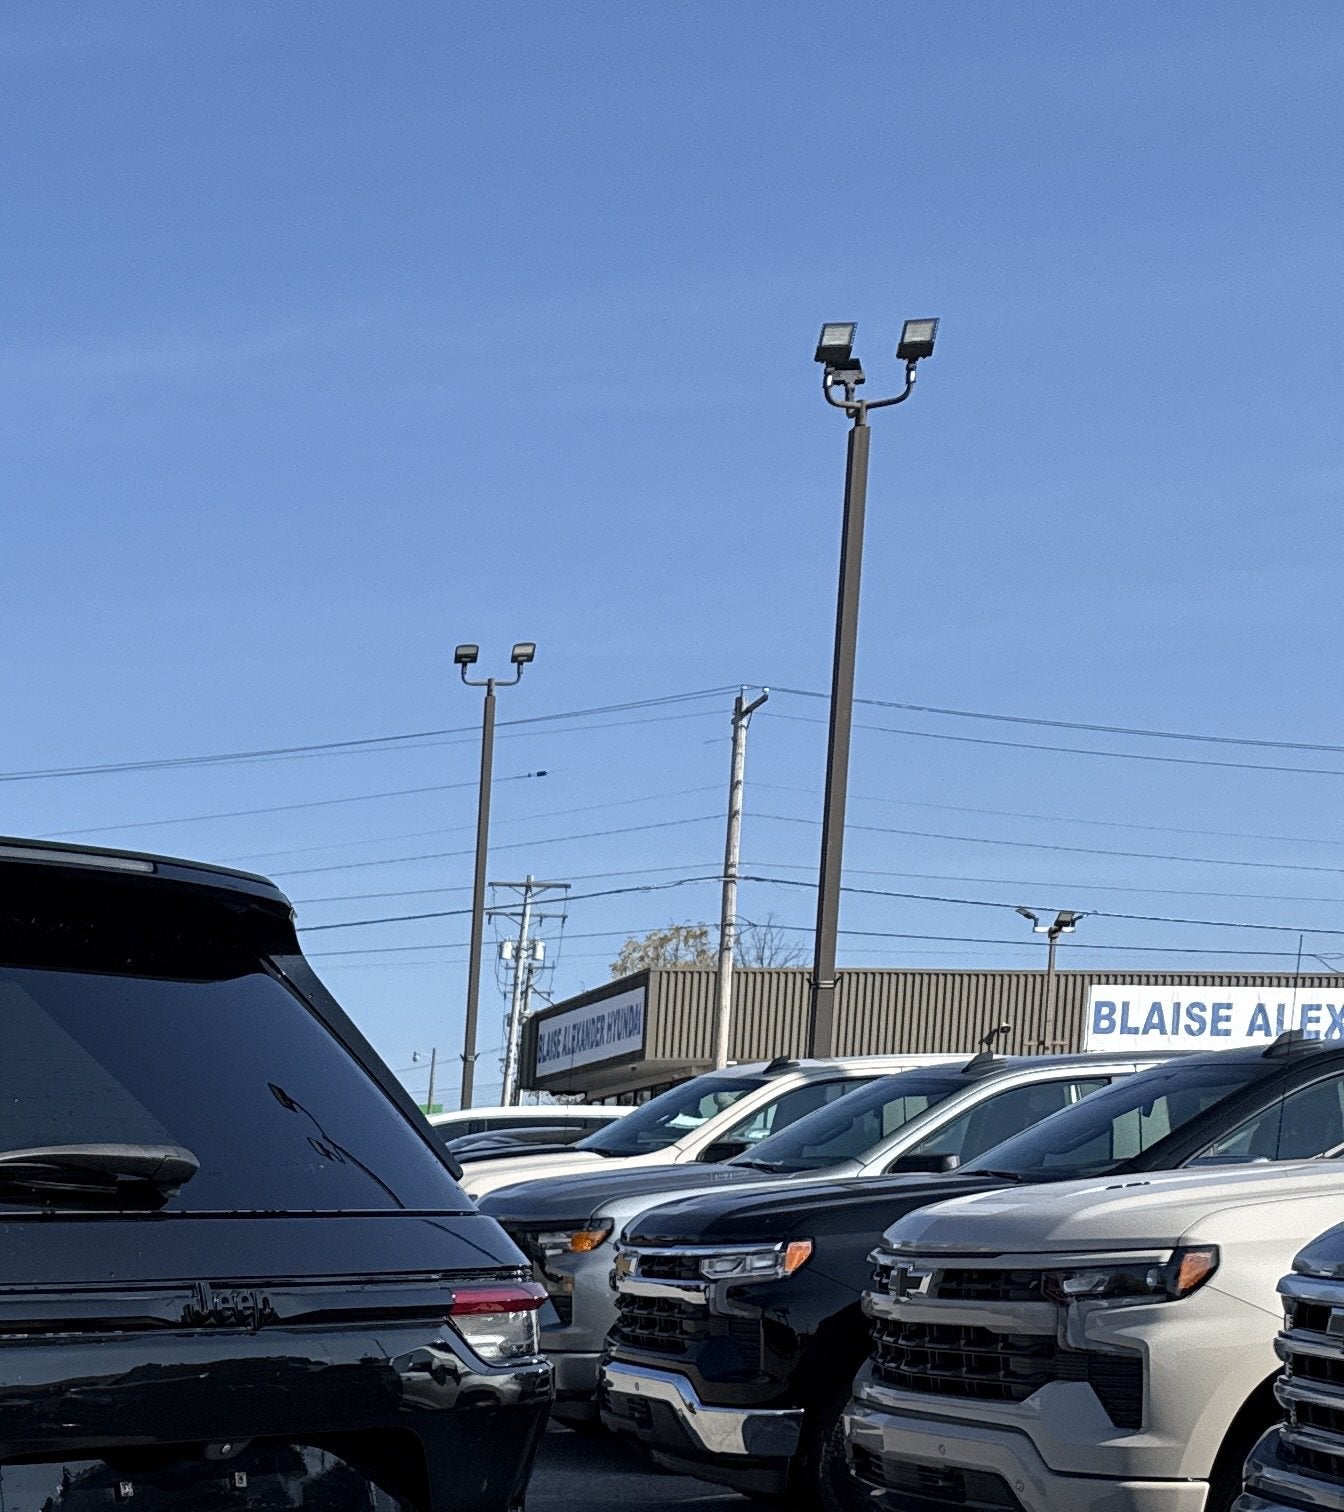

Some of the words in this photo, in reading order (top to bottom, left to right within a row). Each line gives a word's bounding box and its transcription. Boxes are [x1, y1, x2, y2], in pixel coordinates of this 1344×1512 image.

[1092, 1000, 1234, 1037] BLAISE
[1245, 1002, 1344, 1041] ALEX
[182, 1280, 275, 1331] Jeep
